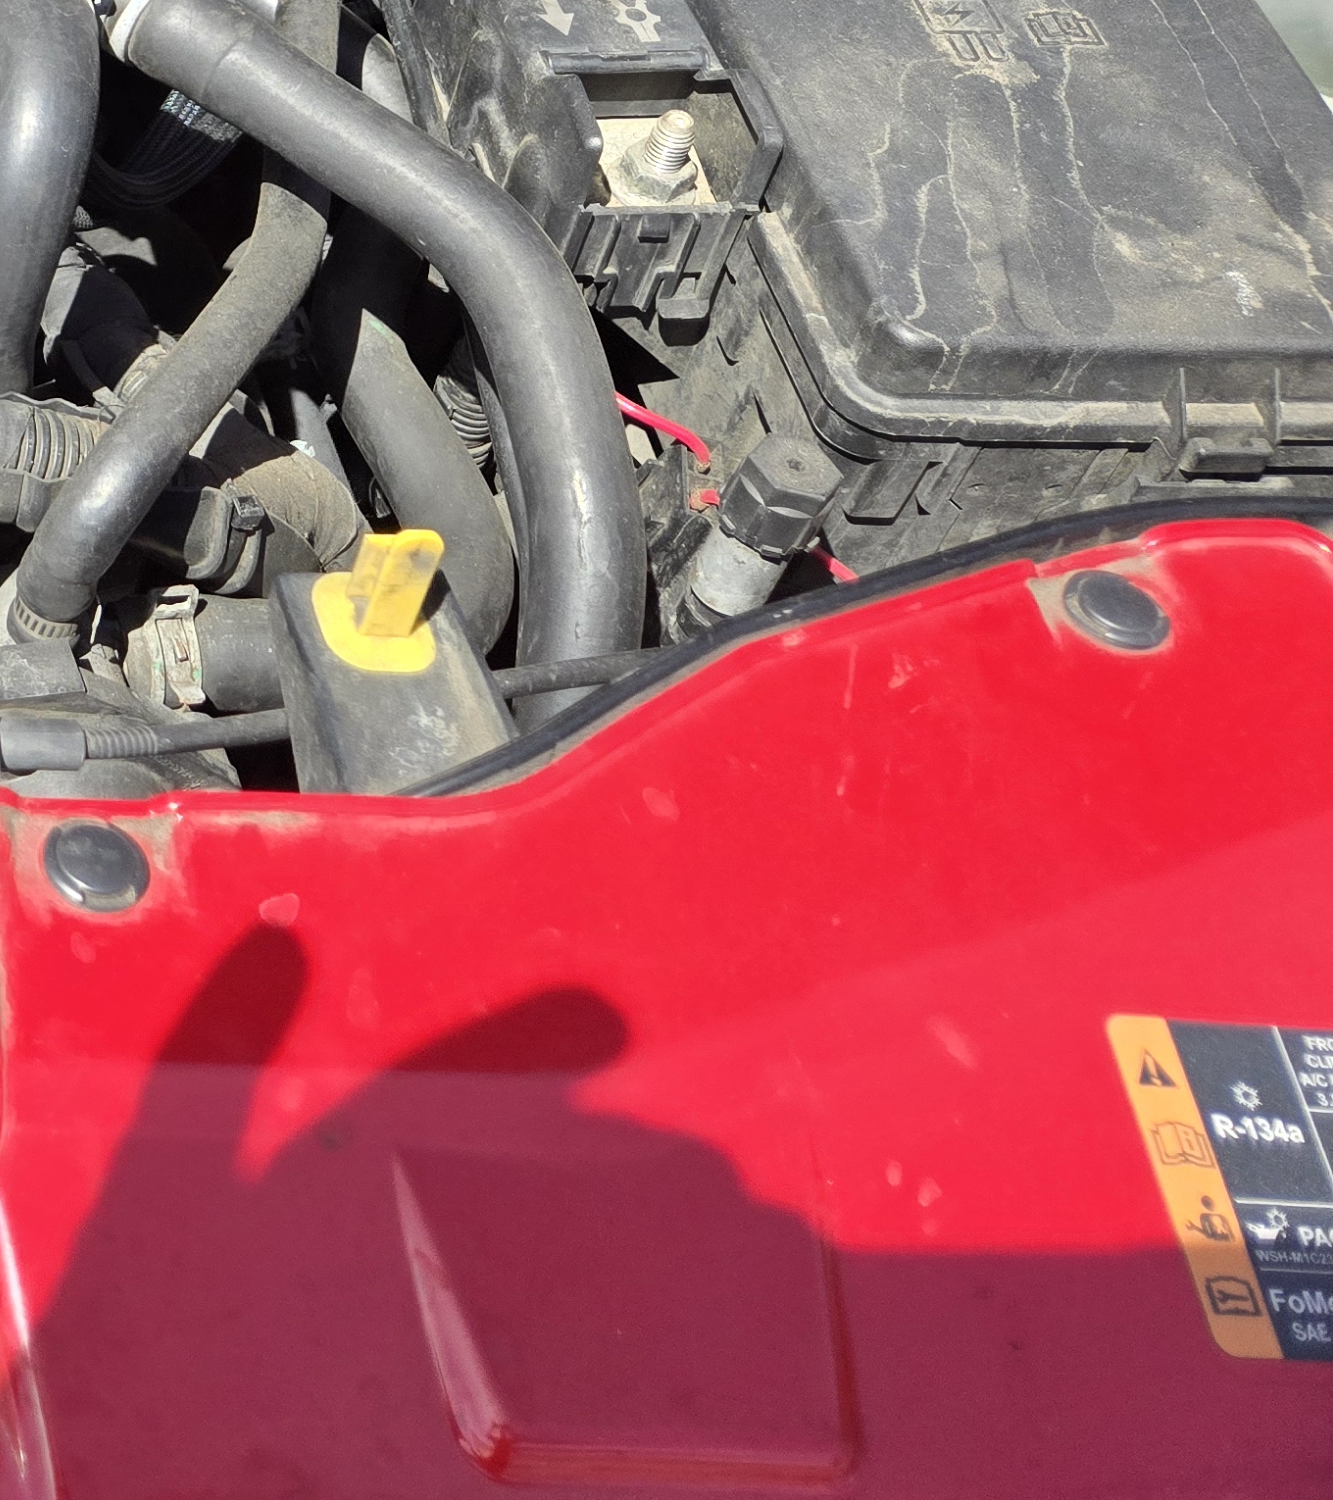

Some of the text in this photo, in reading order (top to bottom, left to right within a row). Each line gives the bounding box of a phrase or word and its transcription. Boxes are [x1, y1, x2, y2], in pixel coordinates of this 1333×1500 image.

[1299, 1073, 1328, 1088] A/C
[1211, 1113, 1305, 1143] R-134a
[1291, 1322, 1331, 1342] SAE
